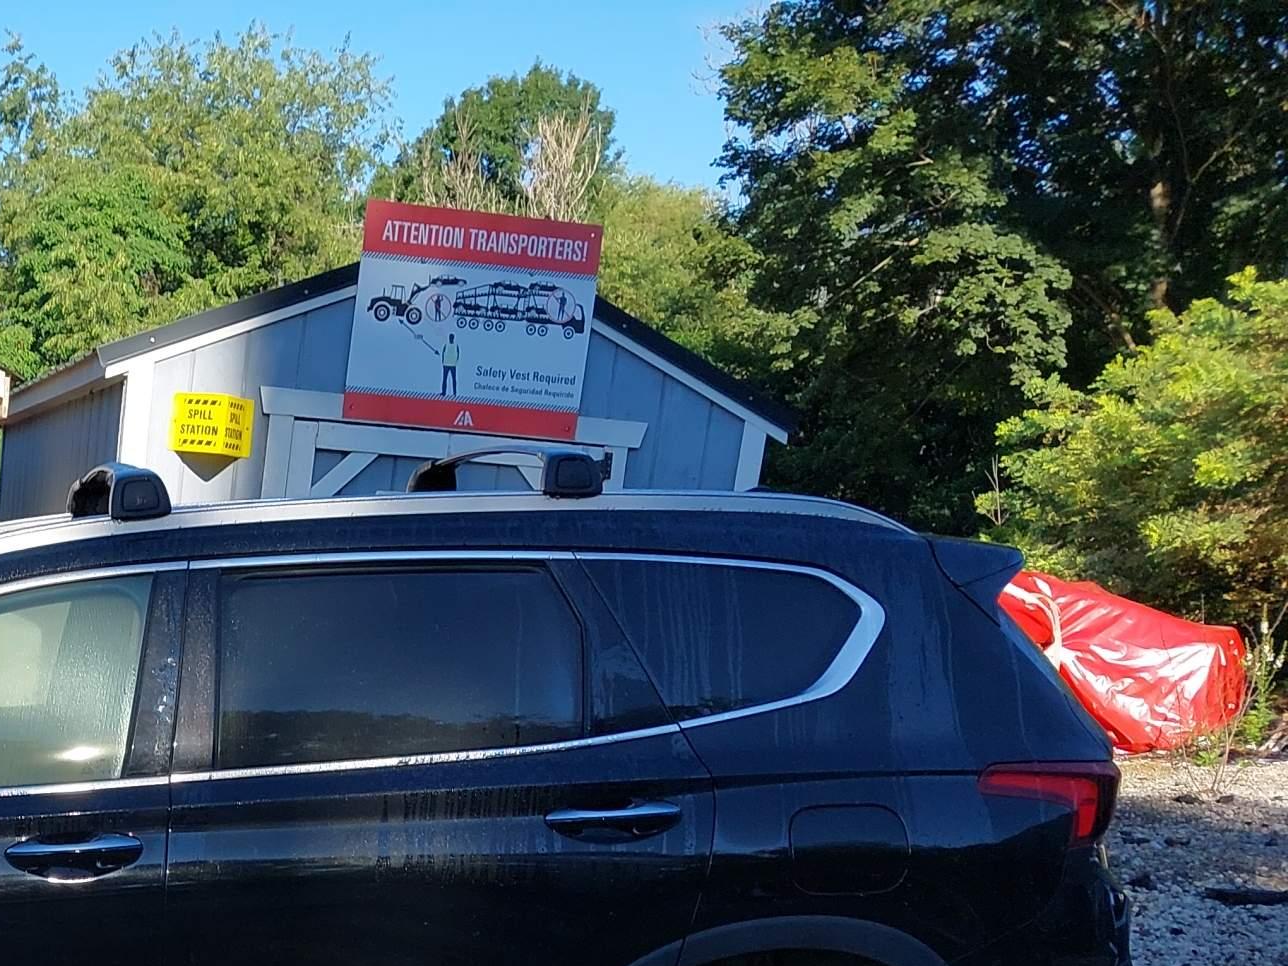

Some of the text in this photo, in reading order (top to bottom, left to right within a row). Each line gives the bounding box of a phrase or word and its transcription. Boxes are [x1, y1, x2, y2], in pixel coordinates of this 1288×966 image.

[382, 220, 588, 262] ATTENTION TRANSPORTERS!
[476, 366, 576, 386] Safety Vest Required
[188, 409, 213, 420] SPILL
[180, 424, 218, 436] STATION
